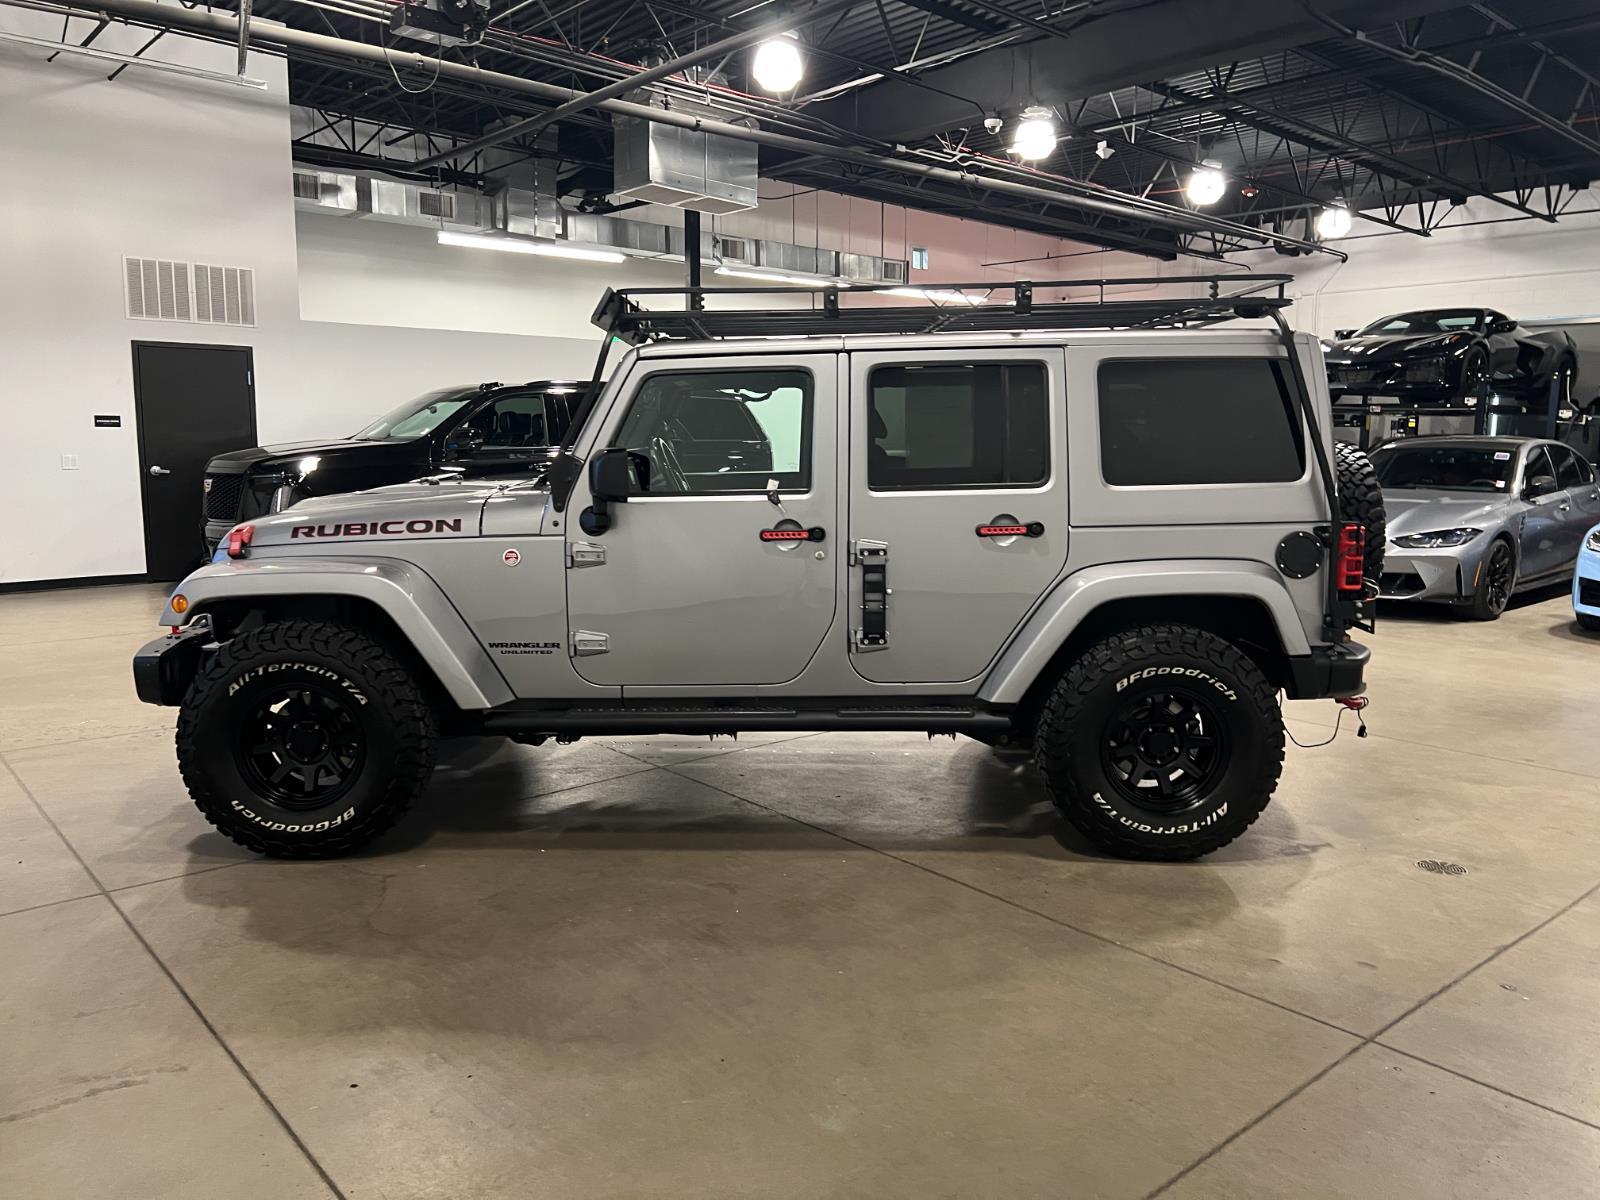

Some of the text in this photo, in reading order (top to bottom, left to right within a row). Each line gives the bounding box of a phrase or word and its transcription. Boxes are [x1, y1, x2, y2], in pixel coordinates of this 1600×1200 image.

[290, 518, 462, 539] RUBICON
[229, 662, 369, 705] All-Terrain T/A
[1115, 666, 1238, 701] BFGoodrich
[231, 800, 356, 833] BFGoodrich
[1092, 792, 1229, 835] All-Terrain T/A
